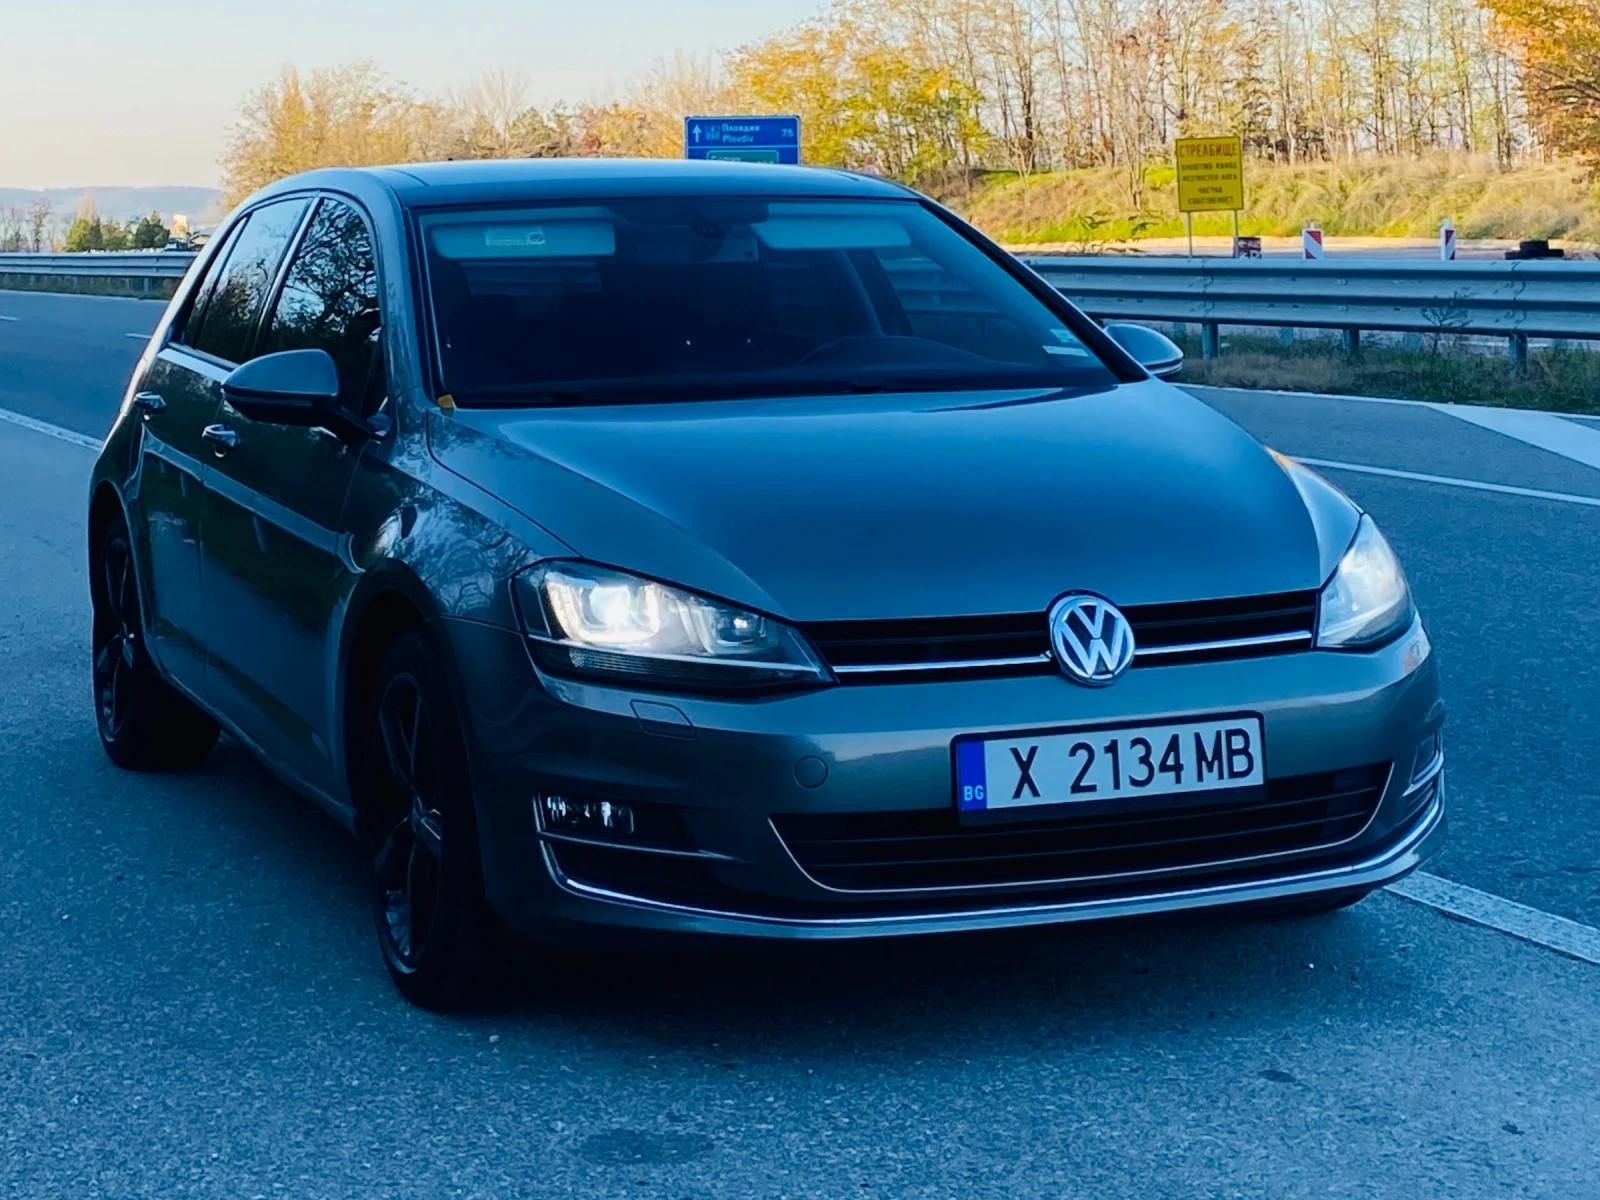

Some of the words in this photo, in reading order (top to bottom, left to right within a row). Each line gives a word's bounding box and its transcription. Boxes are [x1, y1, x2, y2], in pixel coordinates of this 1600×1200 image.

[722, 134, 754, 143] Plovdiv
[781, 128, 794, 137] 75
[1055, 599, 1131, 680] VW
[1009, 745, 1041, 799] X
[1068, 733, 1184, 794] 2134
[1194, 728, 1254, 783] MB
[963, 785, 984, 801] BG
